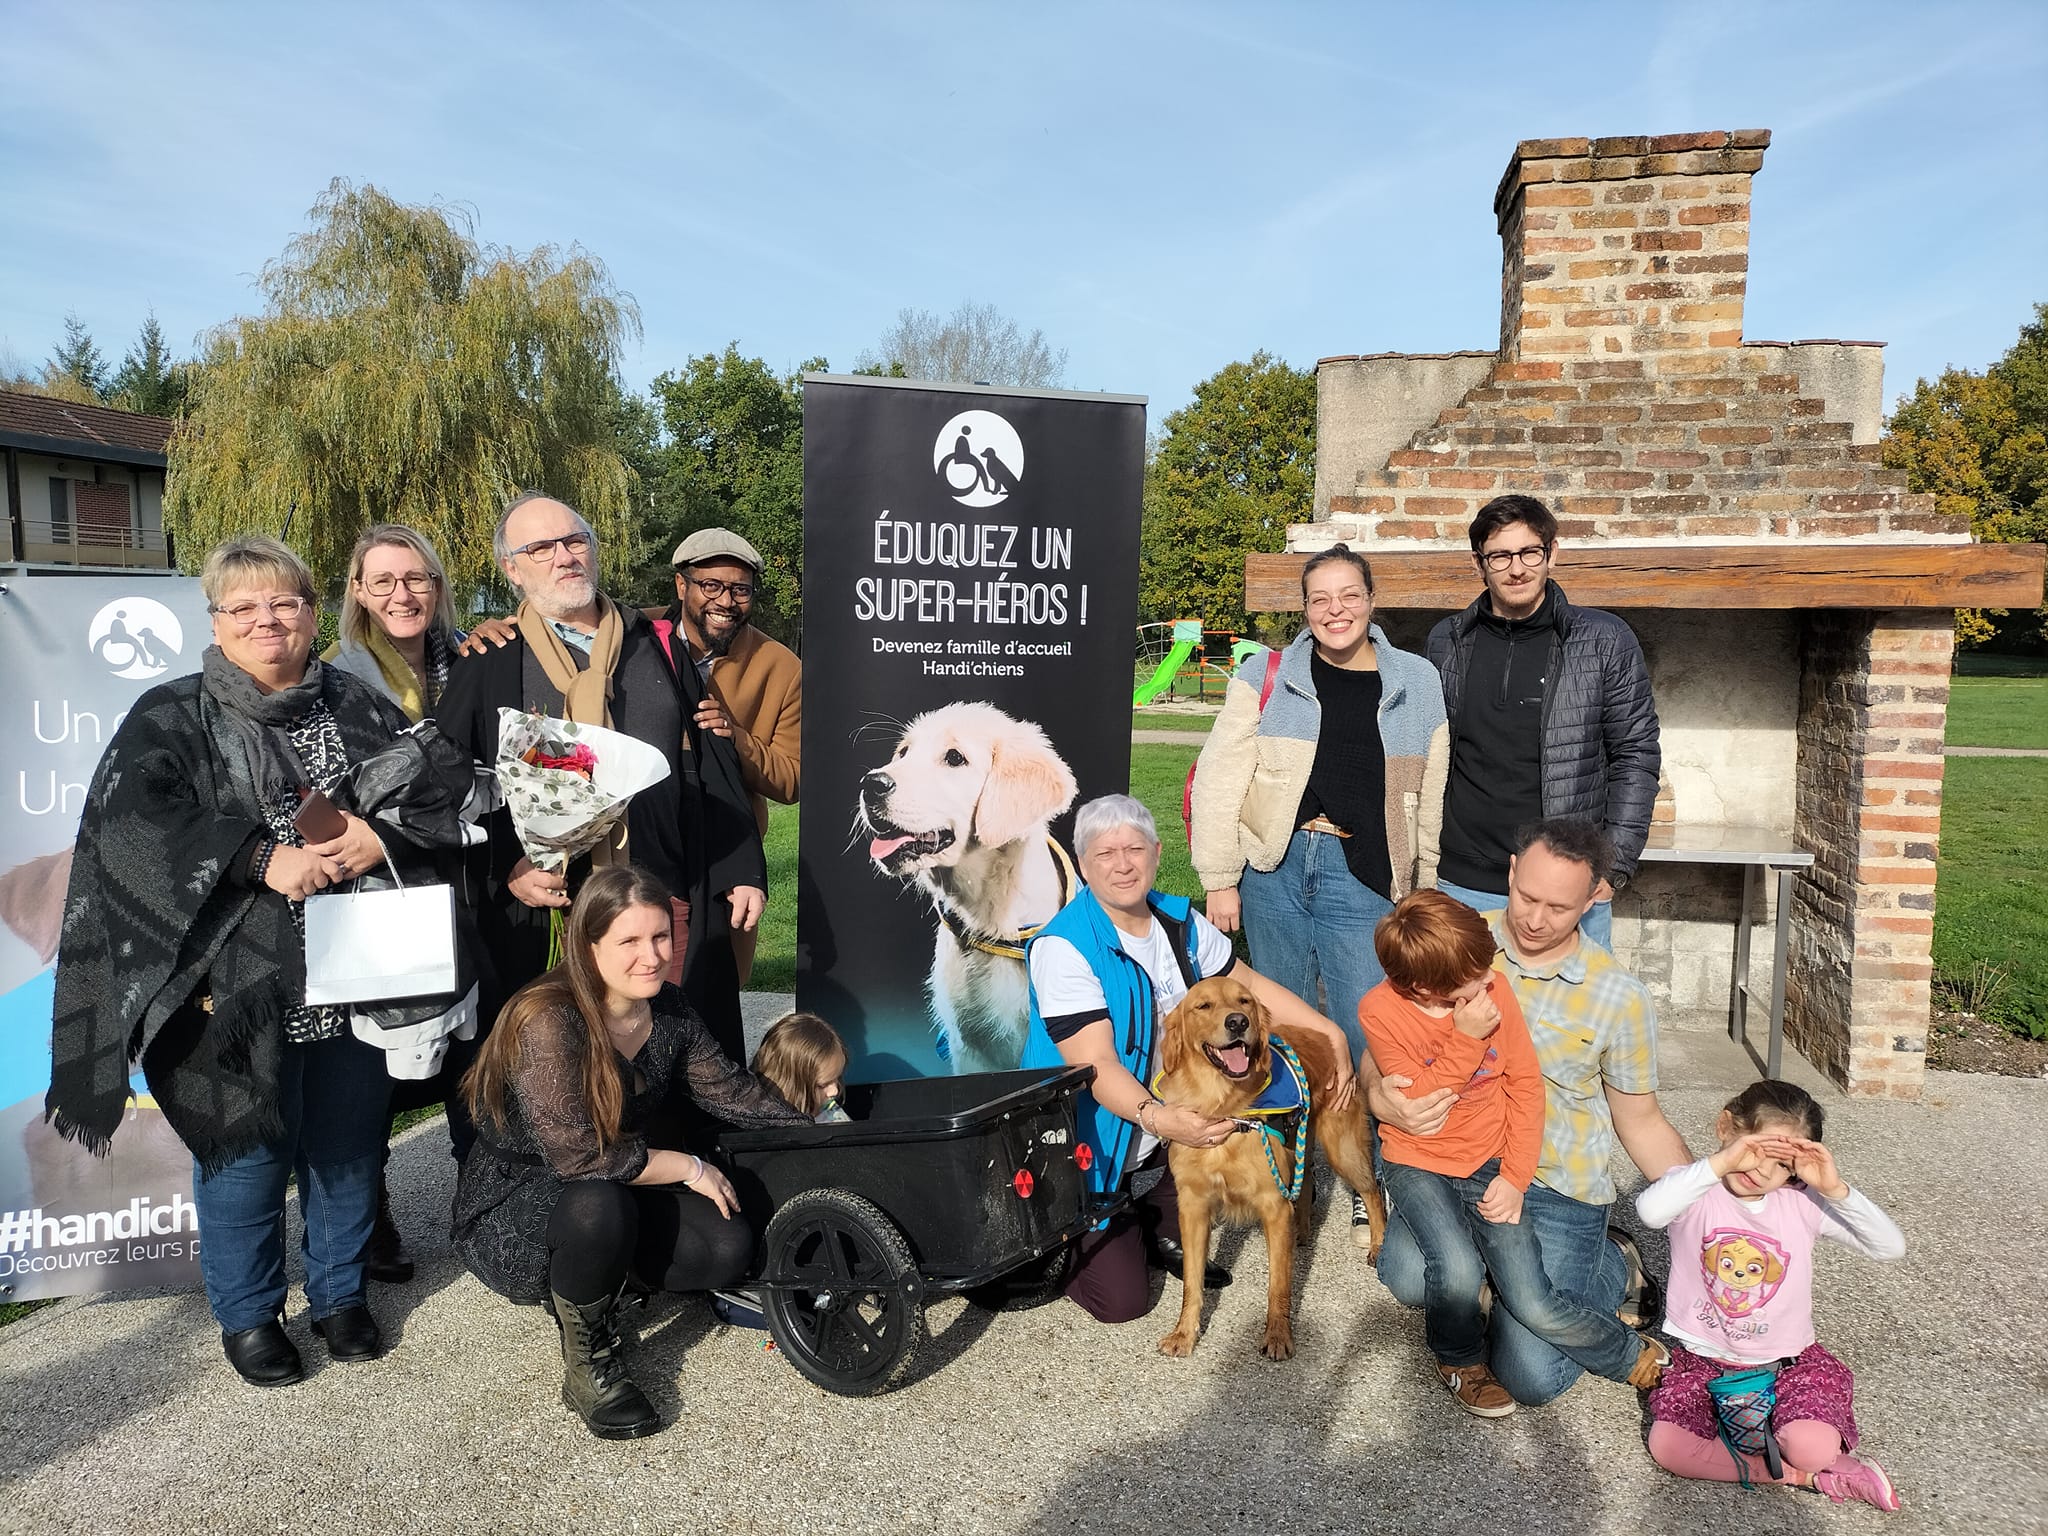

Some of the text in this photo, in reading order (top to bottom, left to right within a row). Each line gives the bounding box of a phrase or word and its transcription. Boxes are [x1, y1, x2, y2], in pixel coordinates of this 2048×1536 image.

[874, 510, 1072, 570] ÉDUQUEZ UN
[855, 572, 1088, 626] SUPER-HÉROS !
[872, 638, 942, 654] Devenez
[946, 639, 1001, 655] famille
[33, 699, 101, 744] Un
[0, 1248, 120, 1277] Découvrez
[127, 1240, 183, 1262] leurs
